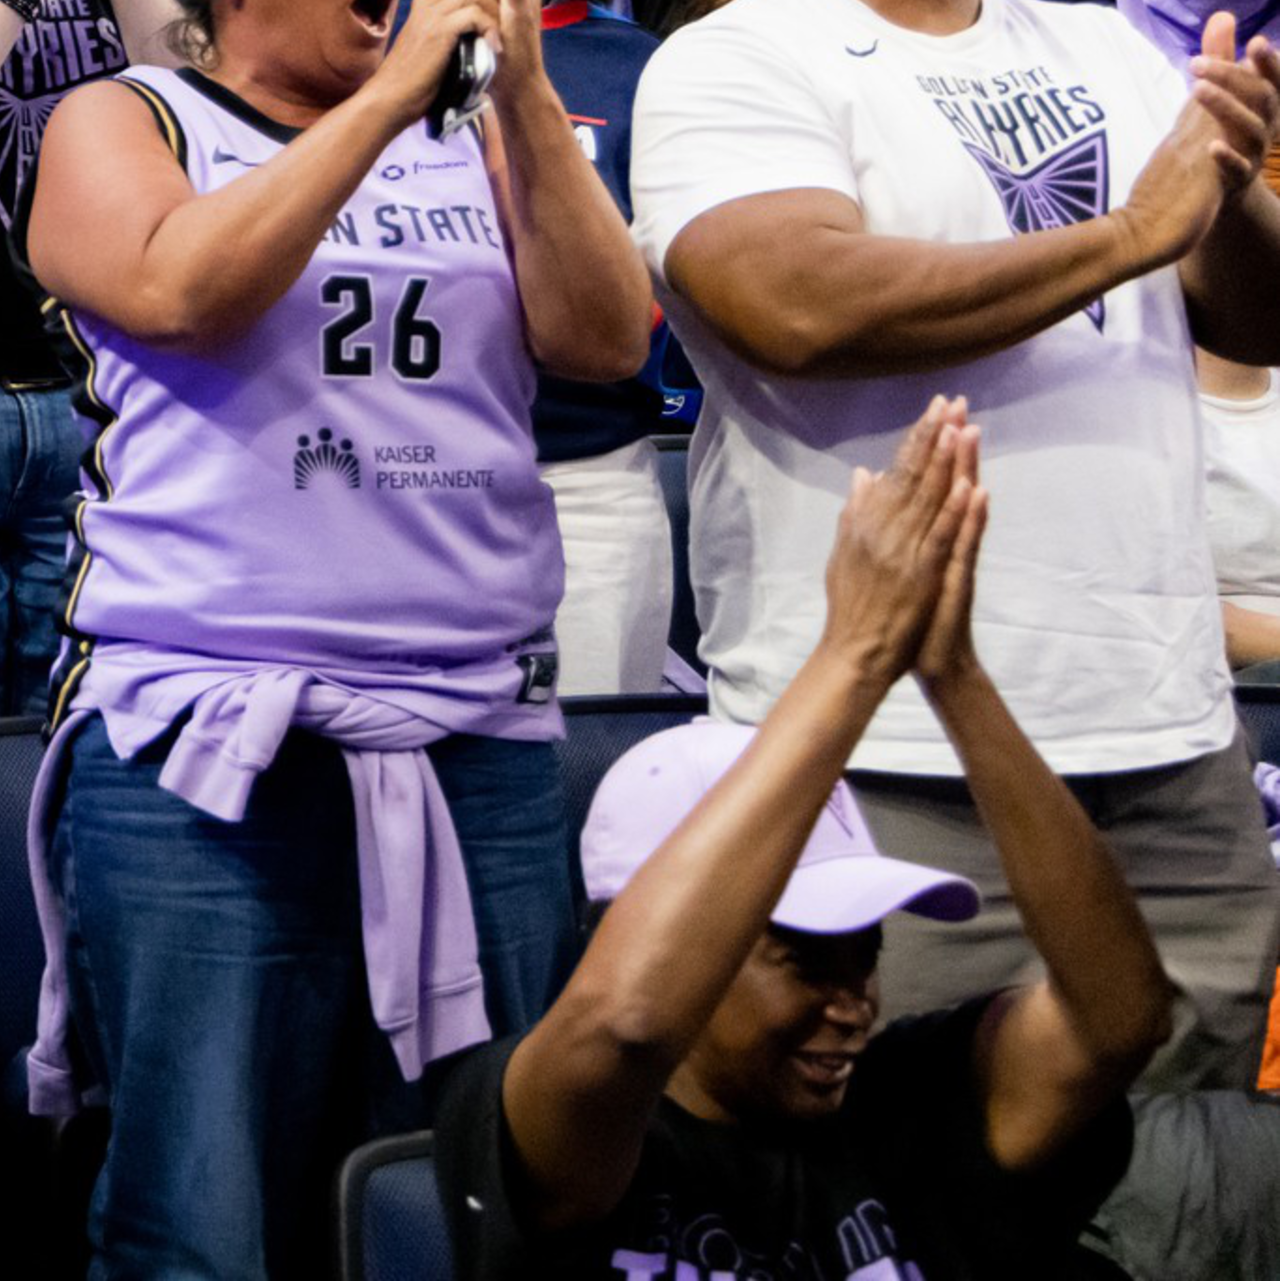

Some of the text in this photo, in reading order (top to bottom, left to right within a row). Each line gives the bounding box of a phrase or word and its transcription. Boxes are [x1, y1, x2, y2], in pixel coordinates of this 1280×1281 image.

[412, 161, 468, 175] freedom
[375, 203, 501, 251] STATE
[319, 272, 442, 382] 26
[374, 445, 437, 464] KAISER
[375, 470, 496, 490] PERMANENTE
